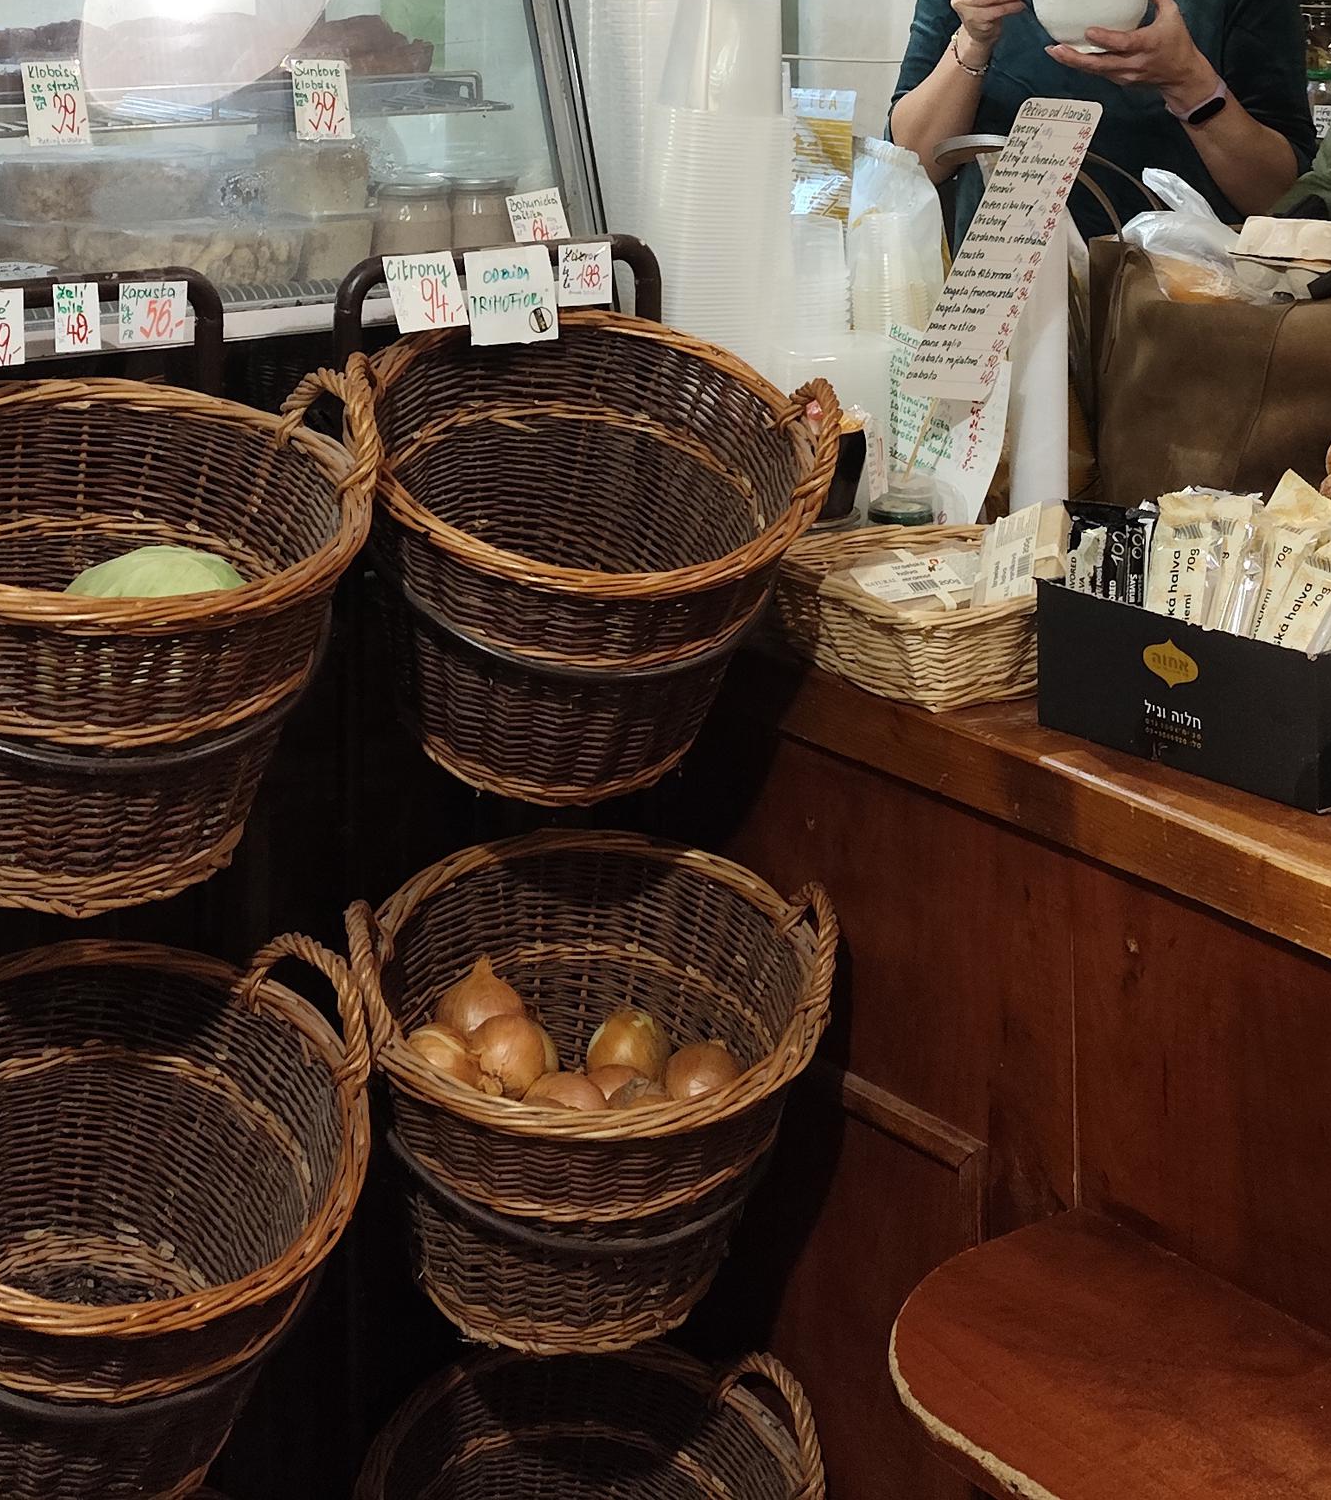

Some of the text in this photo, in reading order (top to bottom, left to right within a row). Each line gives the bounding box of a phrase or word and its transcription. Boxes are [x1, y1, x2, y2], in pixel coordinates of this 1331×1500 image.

[385, 259, 451, 287] Citrony
[121, 283, 176, 306] Kapusta
[1187, 548, 1200, 573] 70g
[1274, 545, 1293, 568] 70g
[1170, 550, 1181, 594] halva
[1287, 582, 1313, 628] halva
[1311, 586, 1331, 608] 70g
